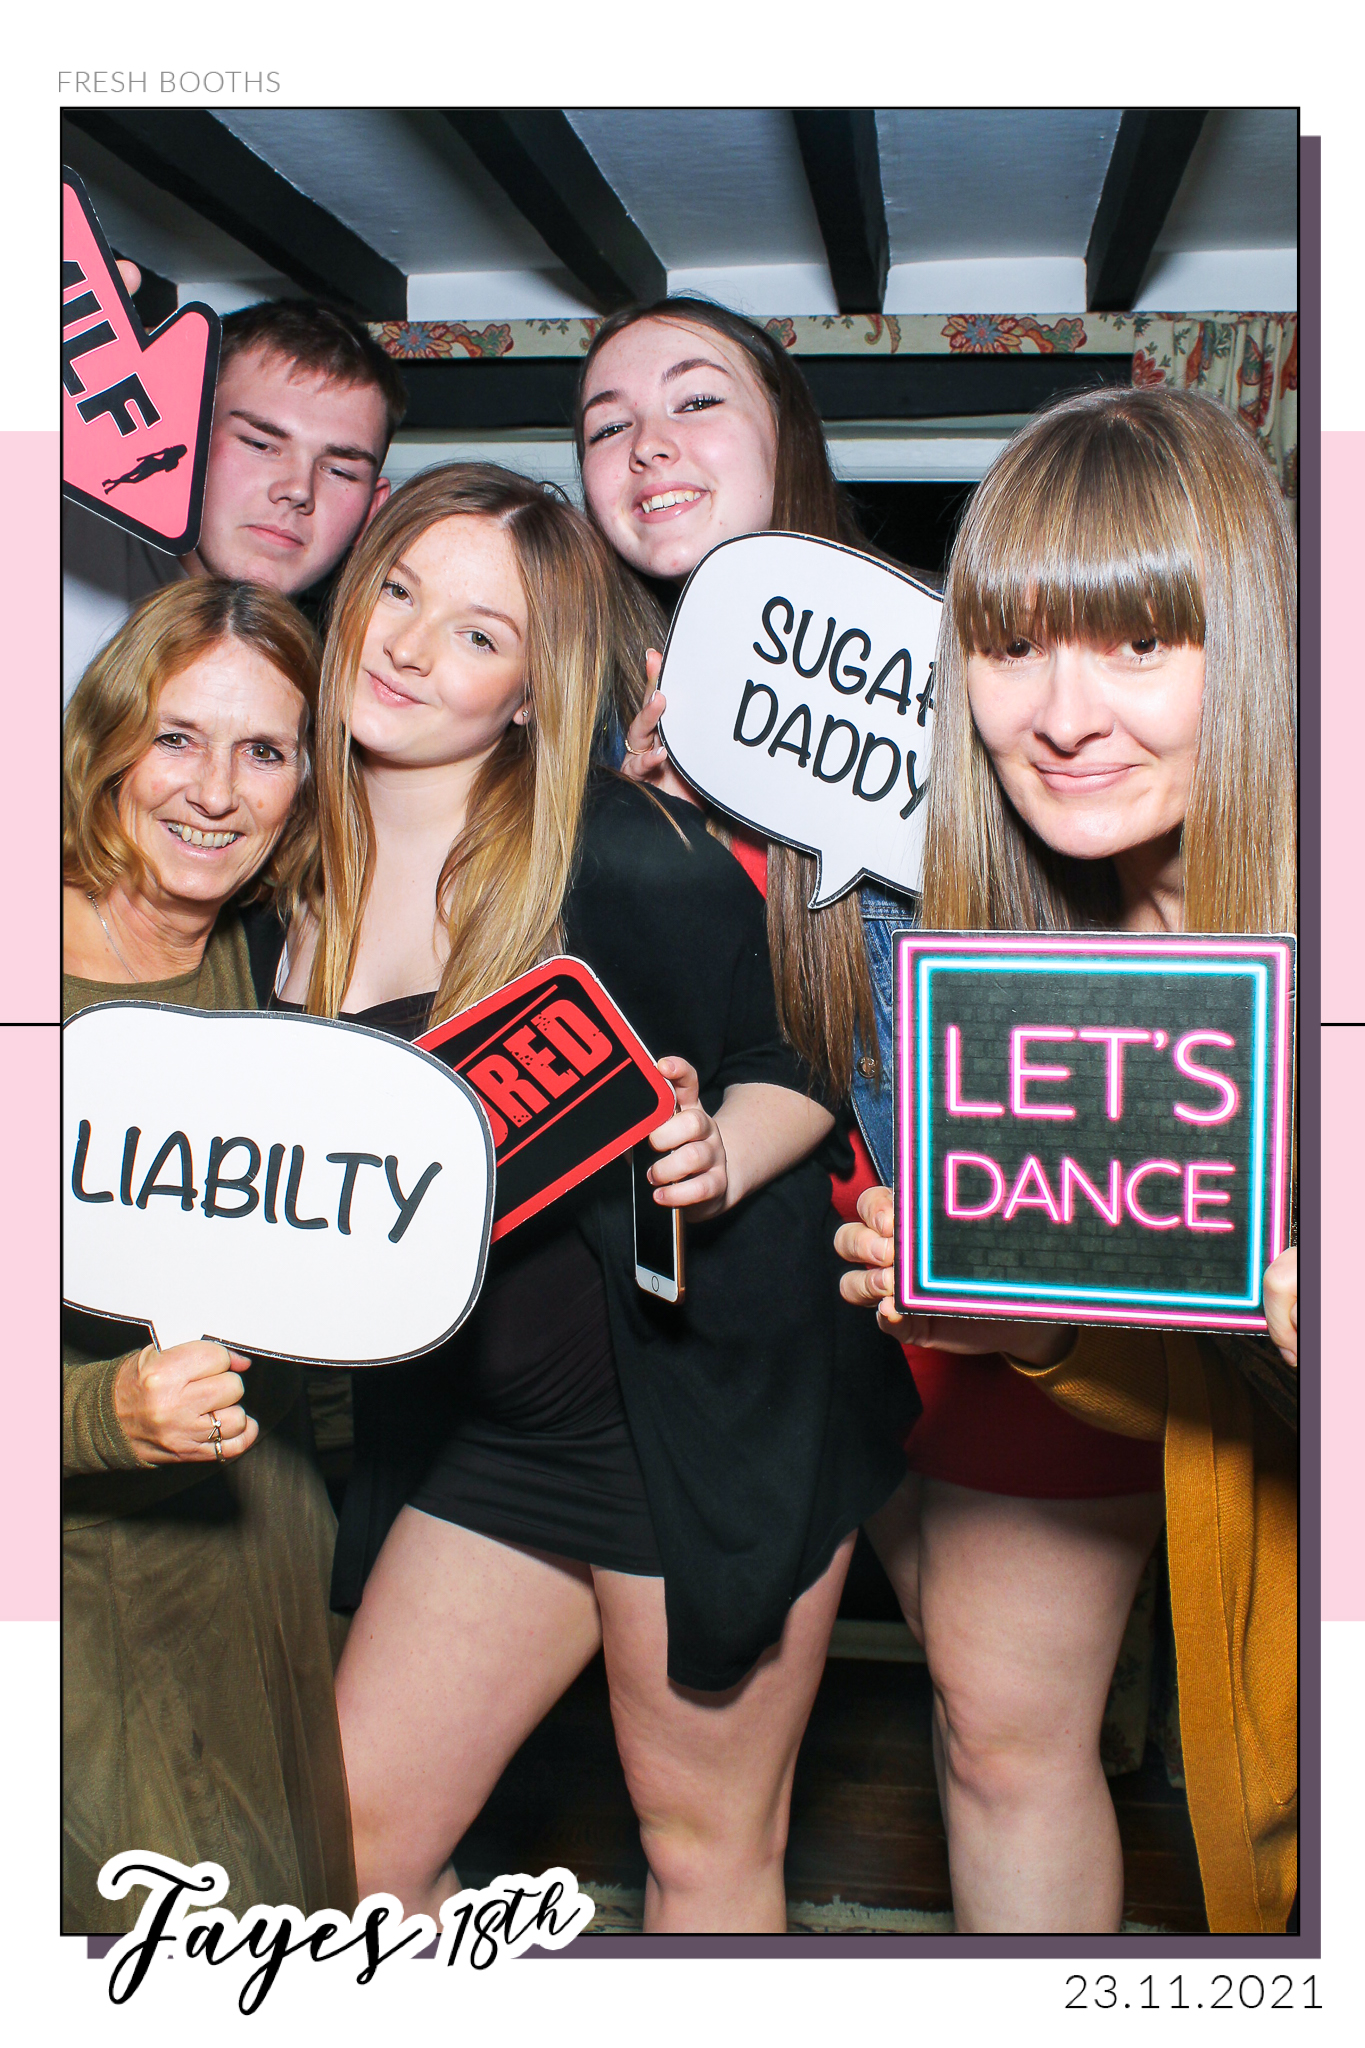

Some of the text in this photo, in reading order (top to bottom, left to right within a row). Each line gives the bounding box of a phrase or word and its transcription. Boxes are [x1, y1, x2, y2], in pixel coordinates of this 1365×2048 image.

[63, 261, 162, 437] ILF
[733, 680, 930, 819] DADDY
[466, 1000, 613, 1148] RED
[945, 1025, 1239, 1124] LET'S
[72, 1119, 442, 1243] LIABILTY
[945, 1151, 1236, 1233] DANCE
